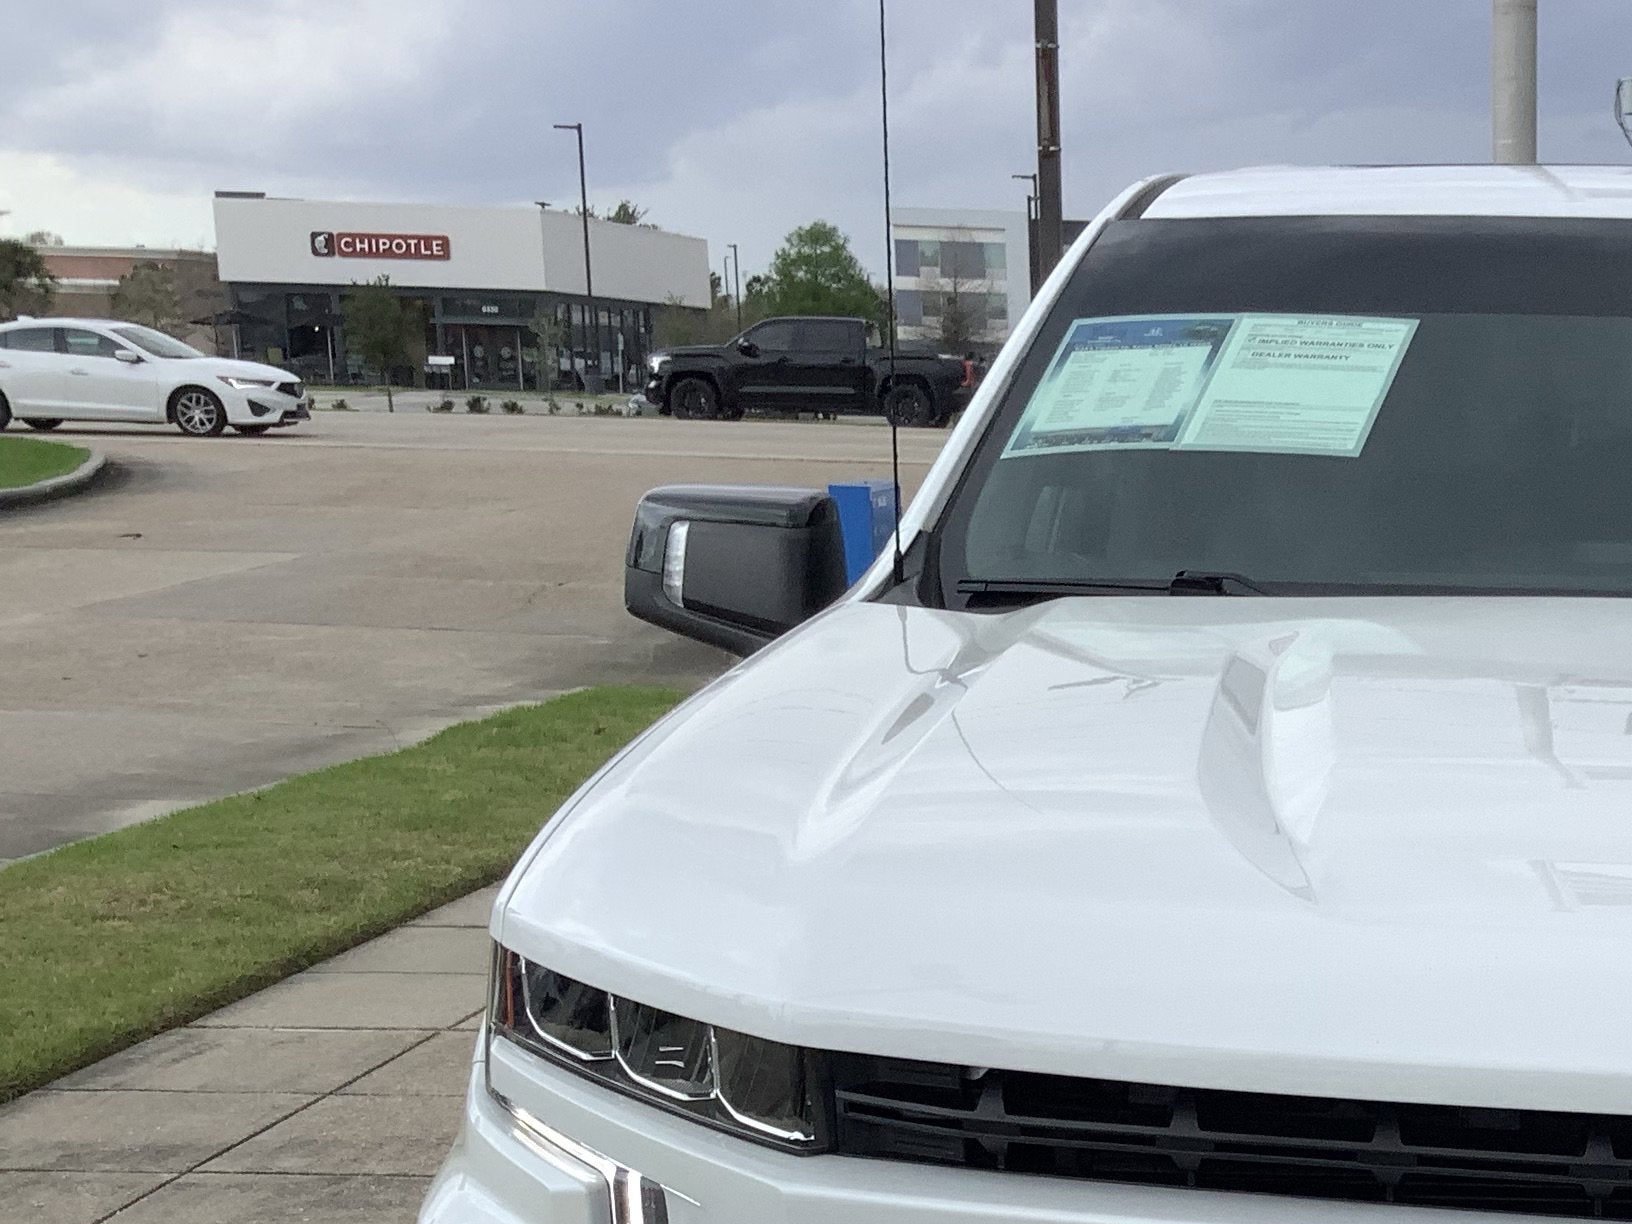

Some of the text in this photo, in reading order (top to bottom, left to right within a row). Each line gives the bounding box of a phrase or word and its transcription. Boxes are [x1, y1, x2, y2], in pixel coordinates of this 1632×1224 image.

[340, 237, 444, 255] CHIPOTLE
[1257, 337, 1395, 350] IMPLIED WARRANTIES ONLY
[1250, 351, 1351, 361] DEALER WARRANTY
